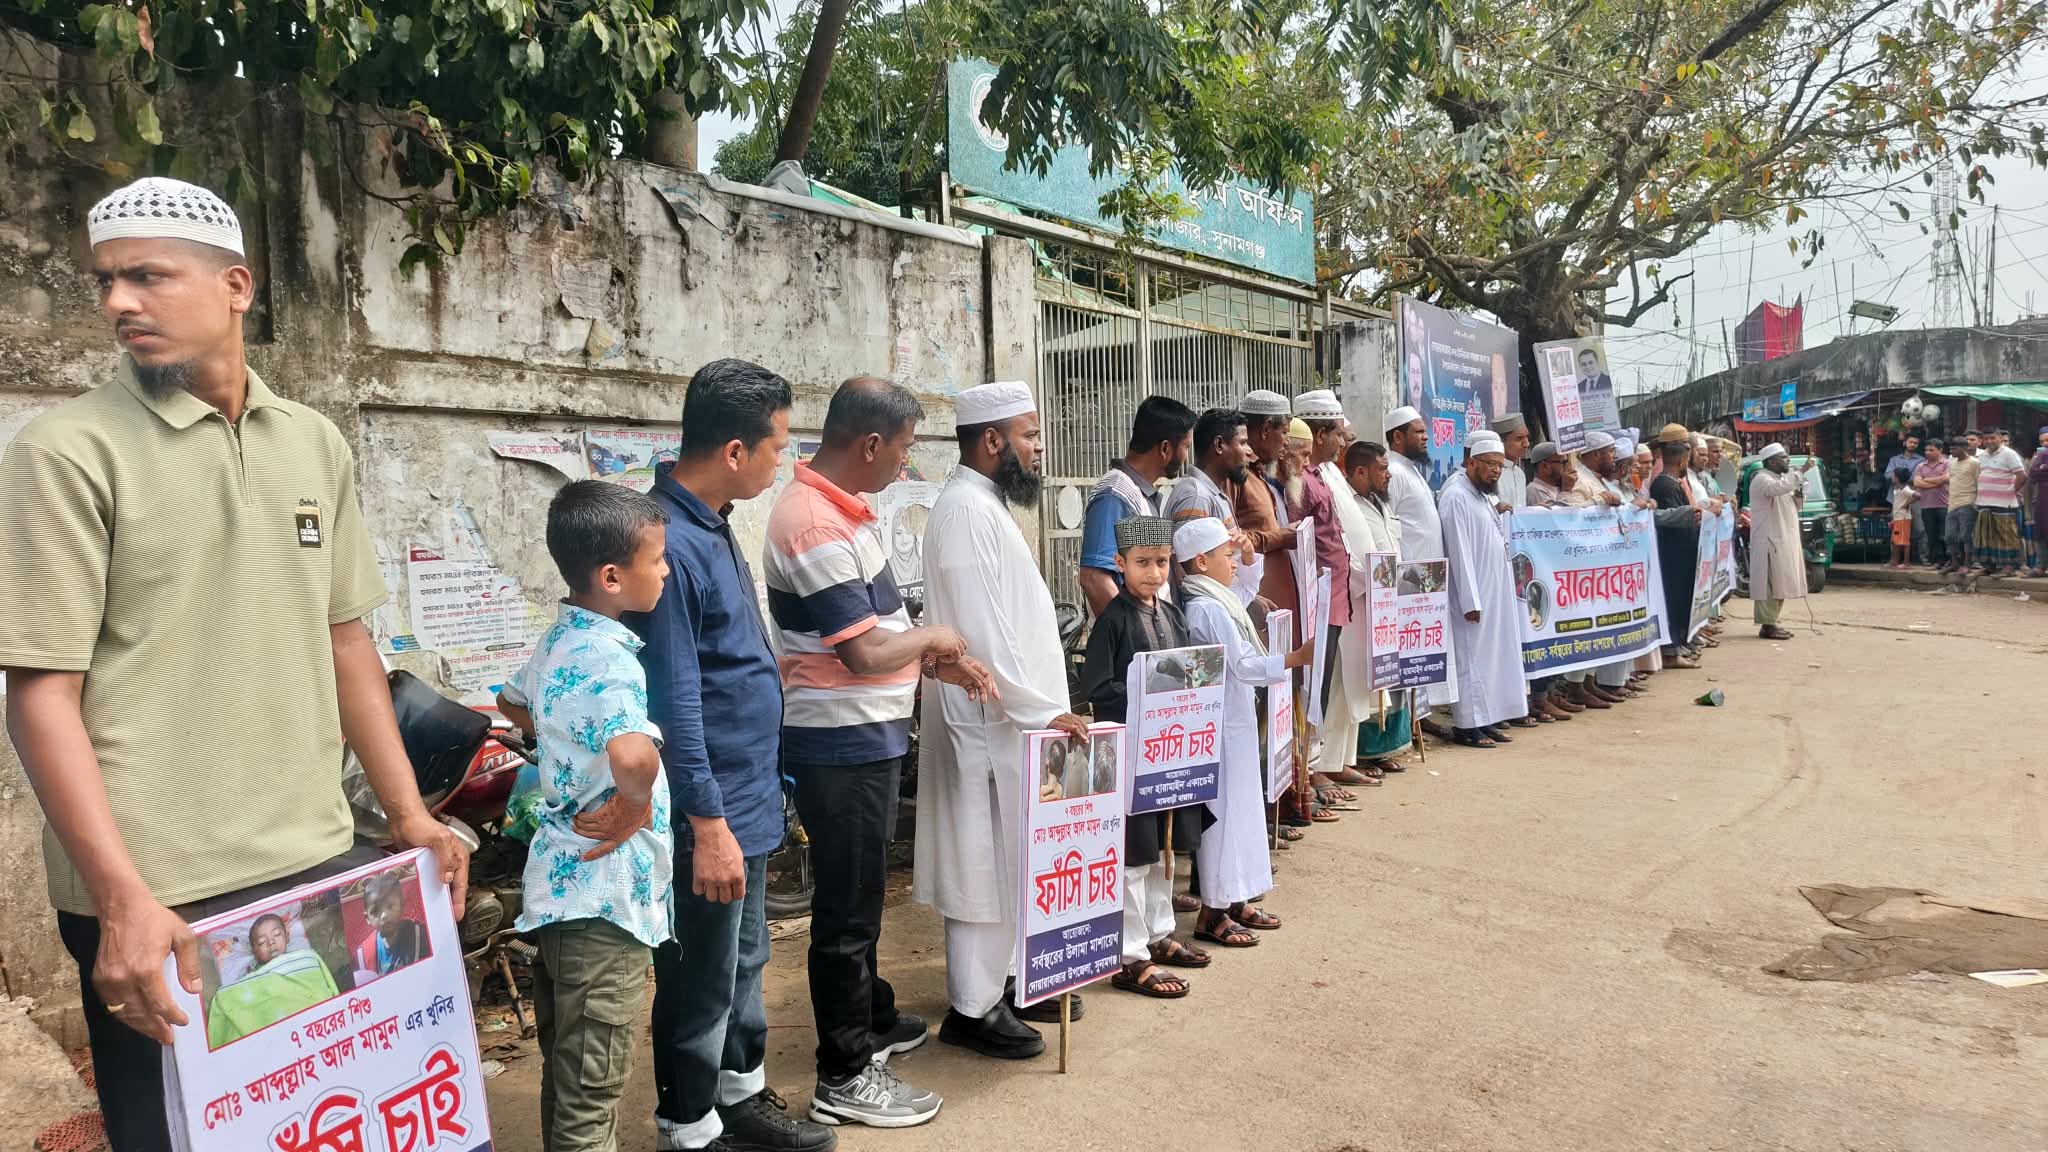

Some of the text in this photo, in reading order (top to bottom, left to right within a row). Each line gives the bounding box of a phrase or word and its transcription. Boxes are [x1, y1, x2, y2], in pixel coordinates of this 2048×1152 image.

[1210, 230, 1266, 259] সুনামগঞ্জ
[1553, 562, 1645, 607] মানববন্ধন
[1144, 721, 1216, 764] ফাঁসি চাই
[1034, 828, 1046, 845] মোঃ
[1048, 824, 1072, 844] আব্দুল্লাহ
[1073, 821, 1085, 837] আল
[1087, 818, 1101, 838] মামুন
[1035, 847, 1117, 915] ফাঁসি চাই
[1066, 941, 1088, 960] উলামা
[1028, 971, 1066, 994] দোয়ারাবাজার
[291, 996, 372, 1049] ৭ বছরের শিশু
[204, 994, 455, 1130] মোঃ আব্দুল্লাহ আল মামুন এর খুনির
[377, 1049, 467, 1152] চাই
